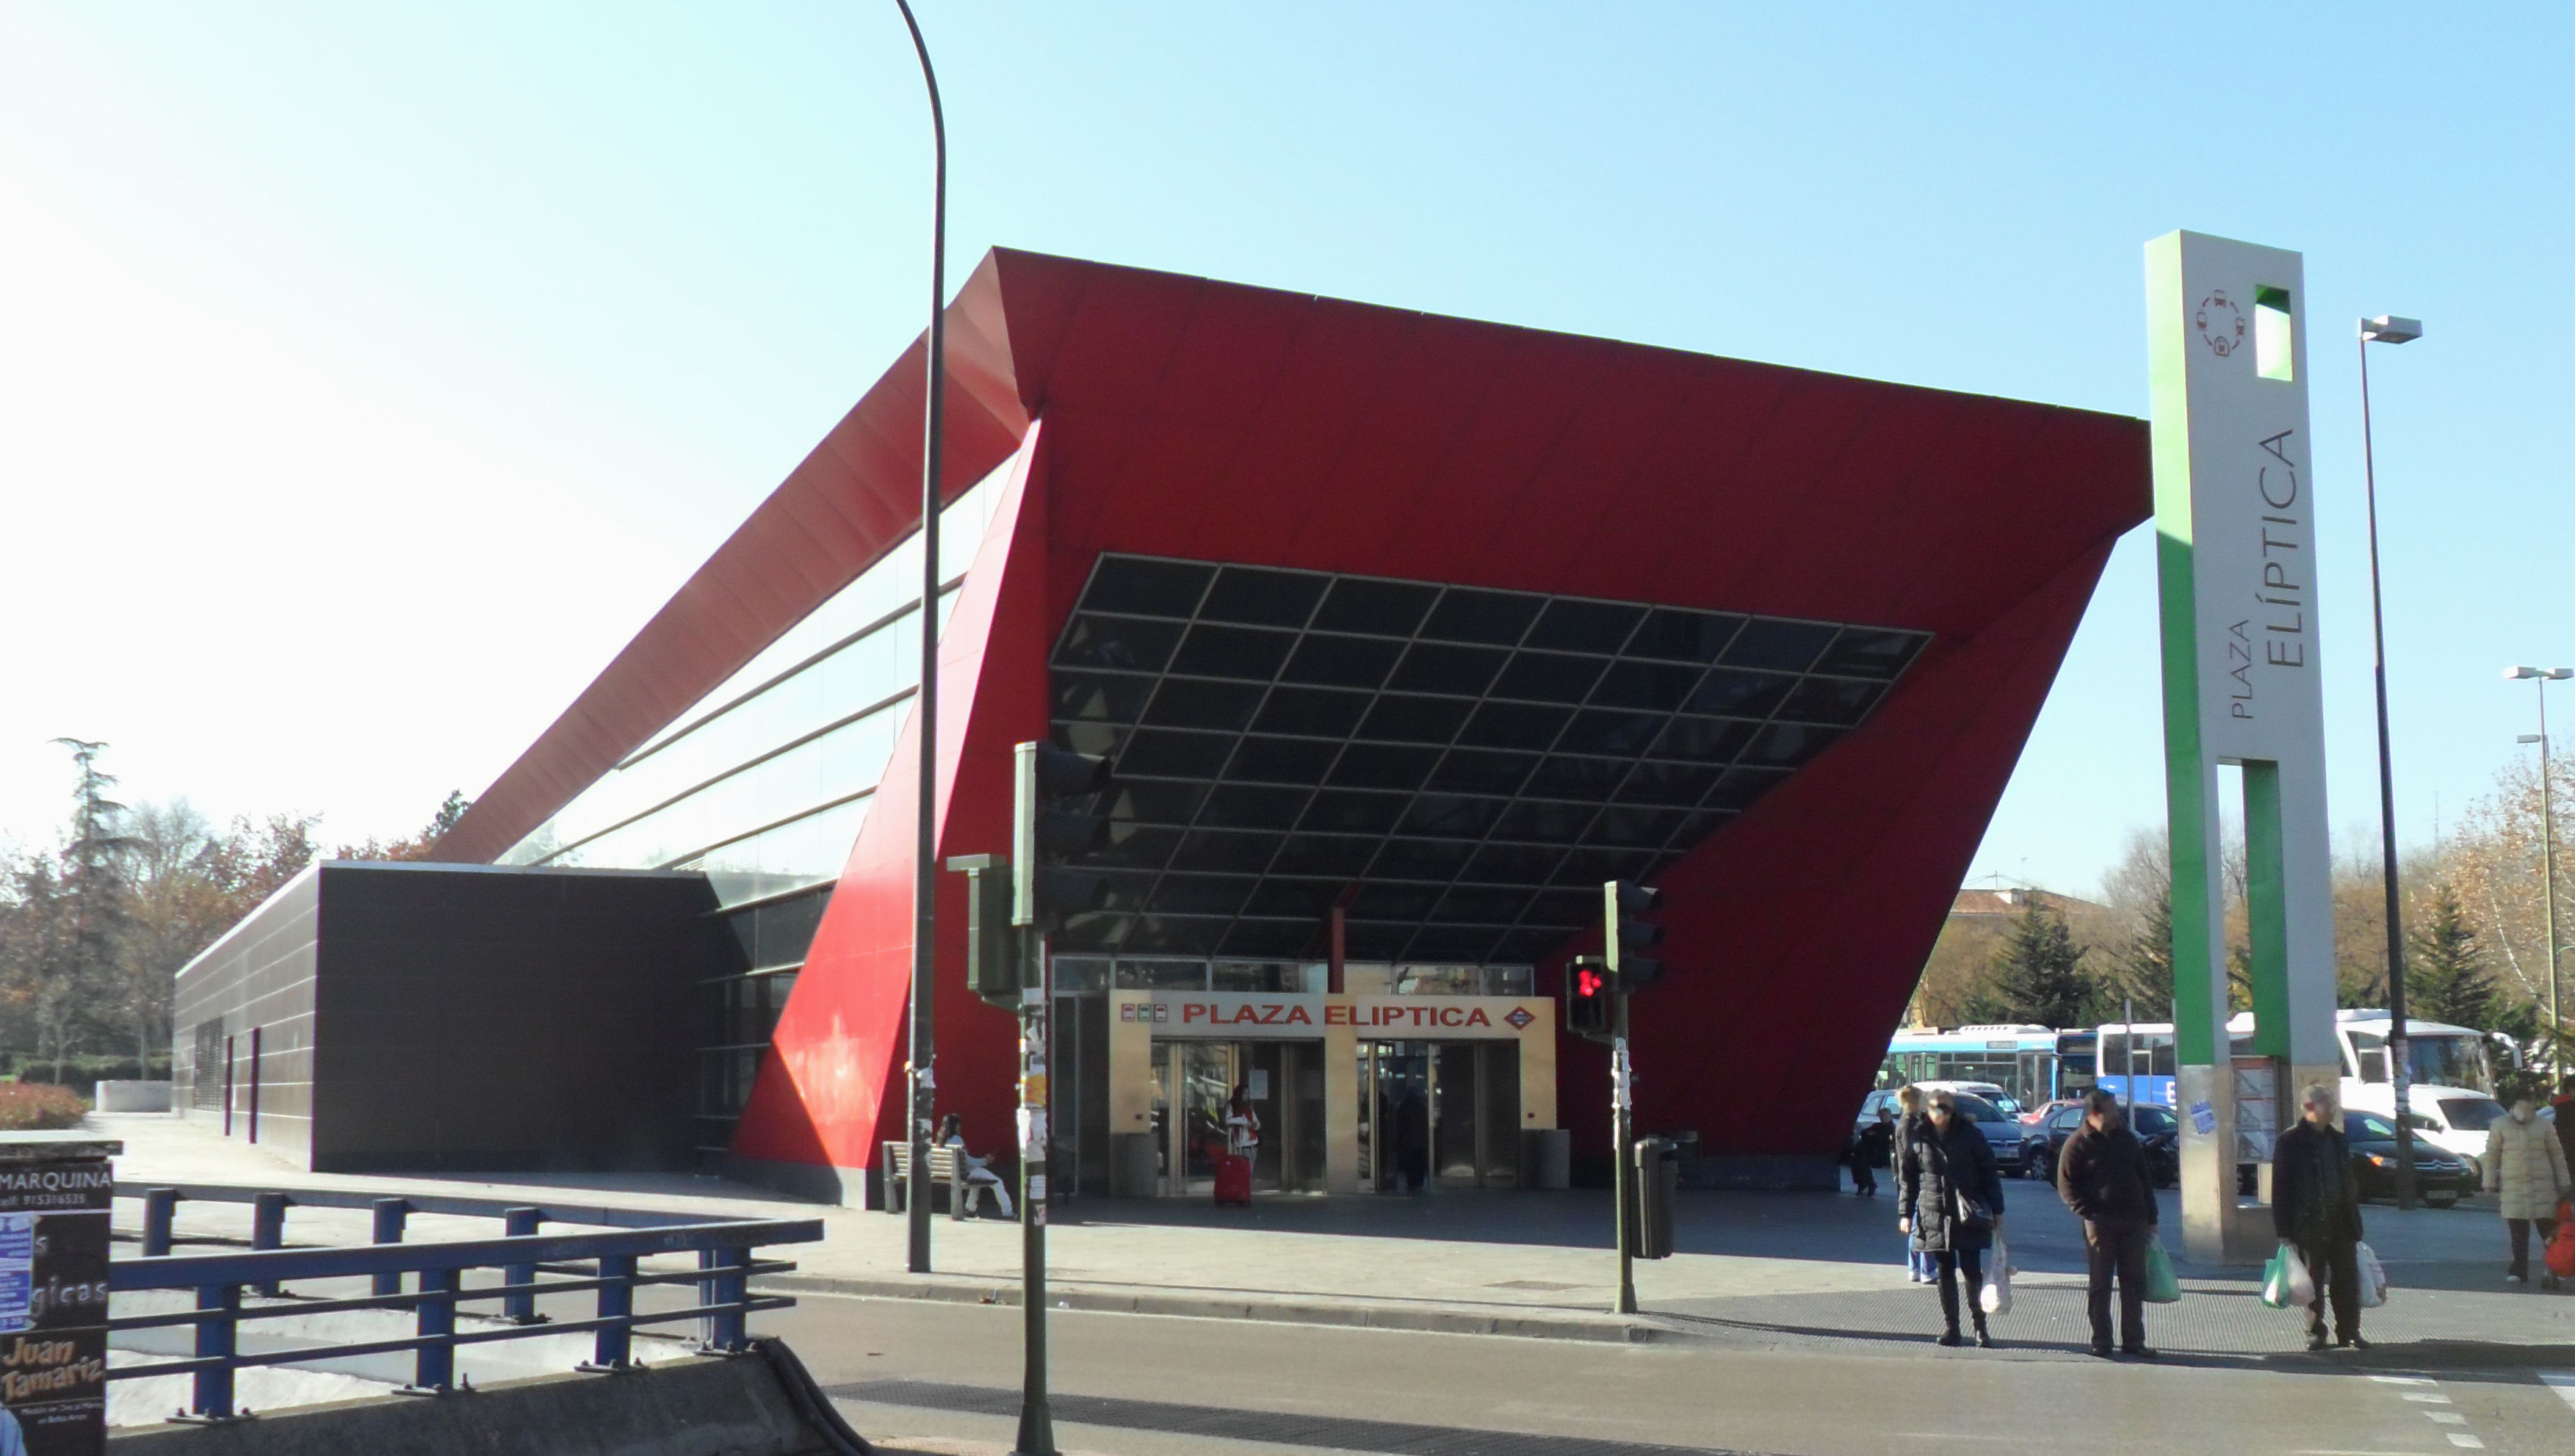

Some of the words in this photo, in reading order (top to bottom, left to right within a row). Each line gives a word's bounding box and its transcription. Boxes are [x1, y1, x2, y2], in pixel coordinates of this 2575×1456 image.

[2255, 429, 2305, 668] ELÍPTICA
[2228, 619, 2253, 720] PLAZA
[1183, 1003, 1312, 1025] PLAZA
[1324, 1005, 1492, 1027] ELIPTICA
[0, 1172, 112, 1191] MARQUINA
[2, 1337, 74, 1366] Juan
[1, 1356, 104, 1403] Tamariz
